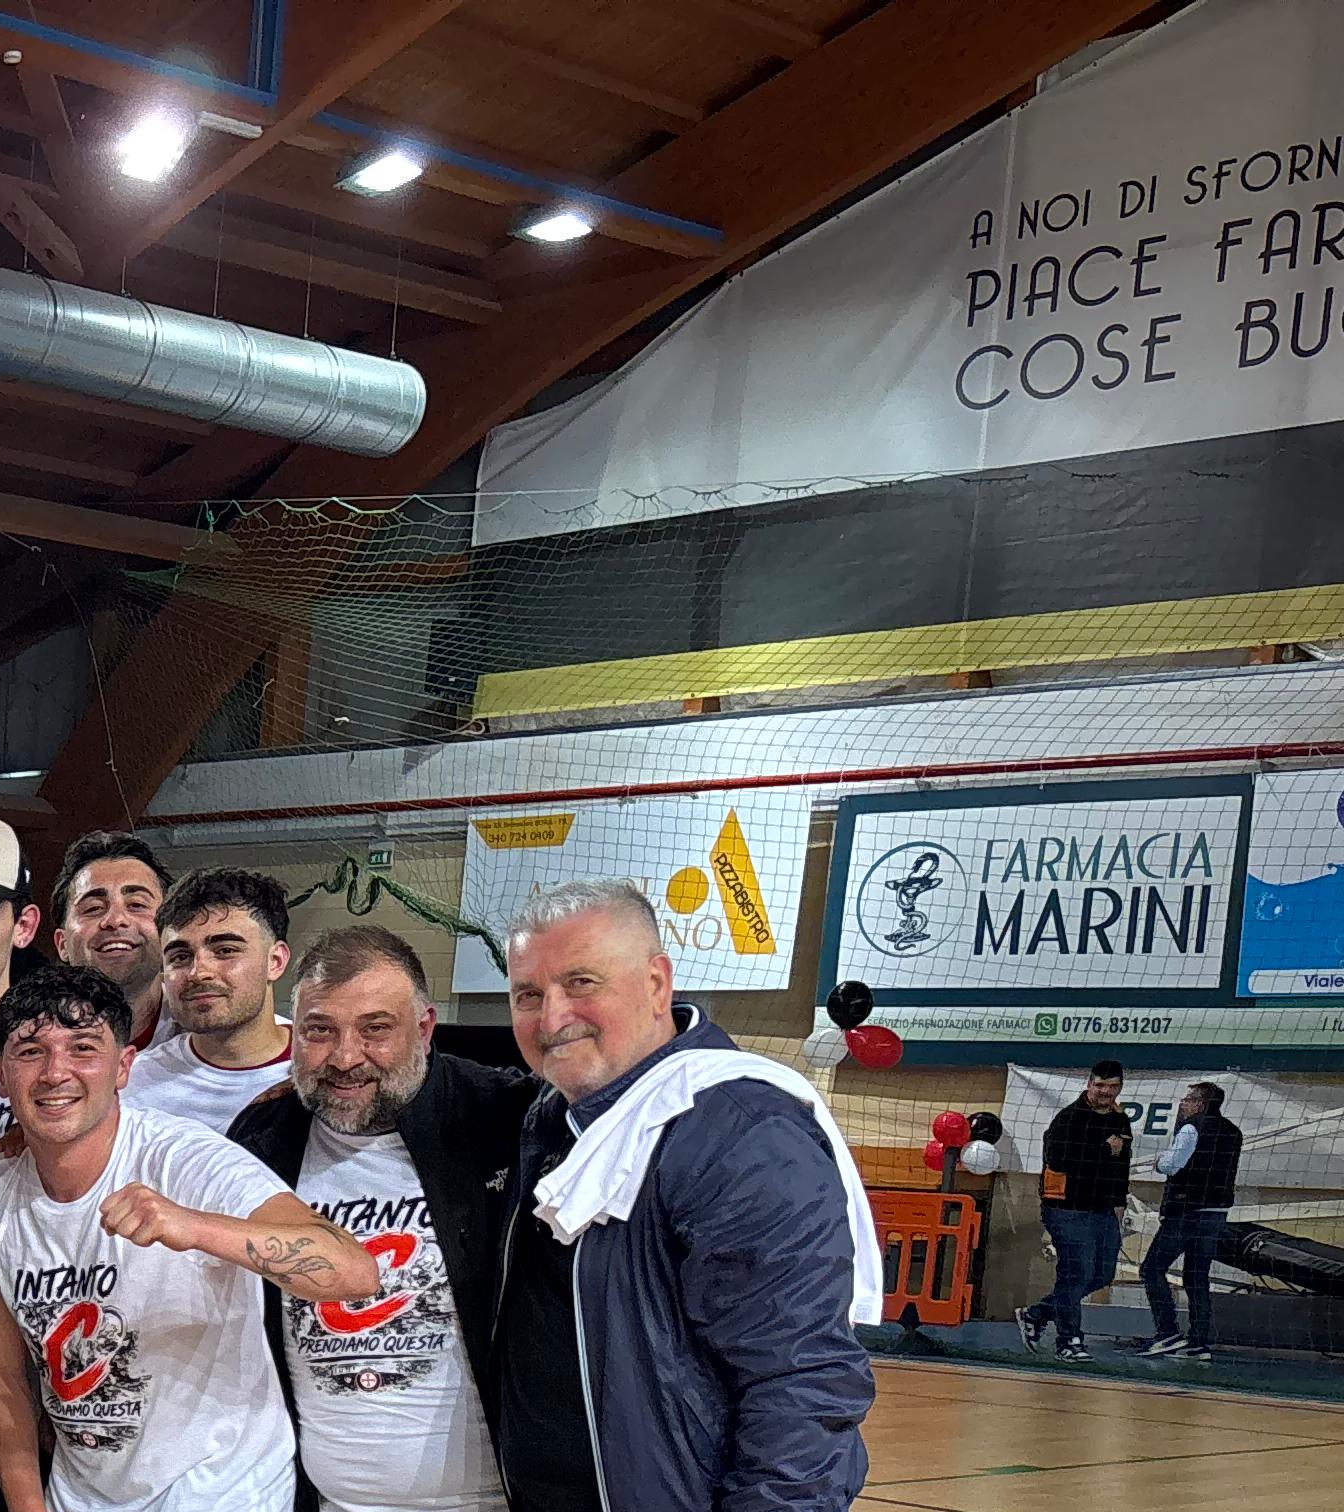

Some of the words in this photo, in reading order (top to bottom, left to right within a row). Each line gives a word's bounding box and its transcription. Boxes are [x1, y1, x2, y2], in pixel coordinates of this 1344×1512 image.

[969, 210, 993, 248] A
[1017, 189, 1091, 240] NOI
[1118, 175, 1158, 219] DI
[966, 234, 1168, 328] PIACE
[955, 314, 1182, 410] COSE
[1234, 287, 1344, 369] BU
[981, 831, 1213, 884] FARMACIA
[713, 853, 770, 944] PIZZABISTRO
[973, 884, 1212, 956] MARINI
[1304, 974, 1344, 988] Viale
[911, 1017, 985, 1029] PRENOTAZIONE
[986, 1017, 1031, 1029] FARMACI
[1061, 1015, 1173, 1035] 0776.831207
[13, 1260, 118, 1302] INTANTO
[298, 1335, 380, 1355] PRENDIAMO
[383, 1332, 447, 1353] QUESTA
[92, 1400, 142, 1418] QUESTA
